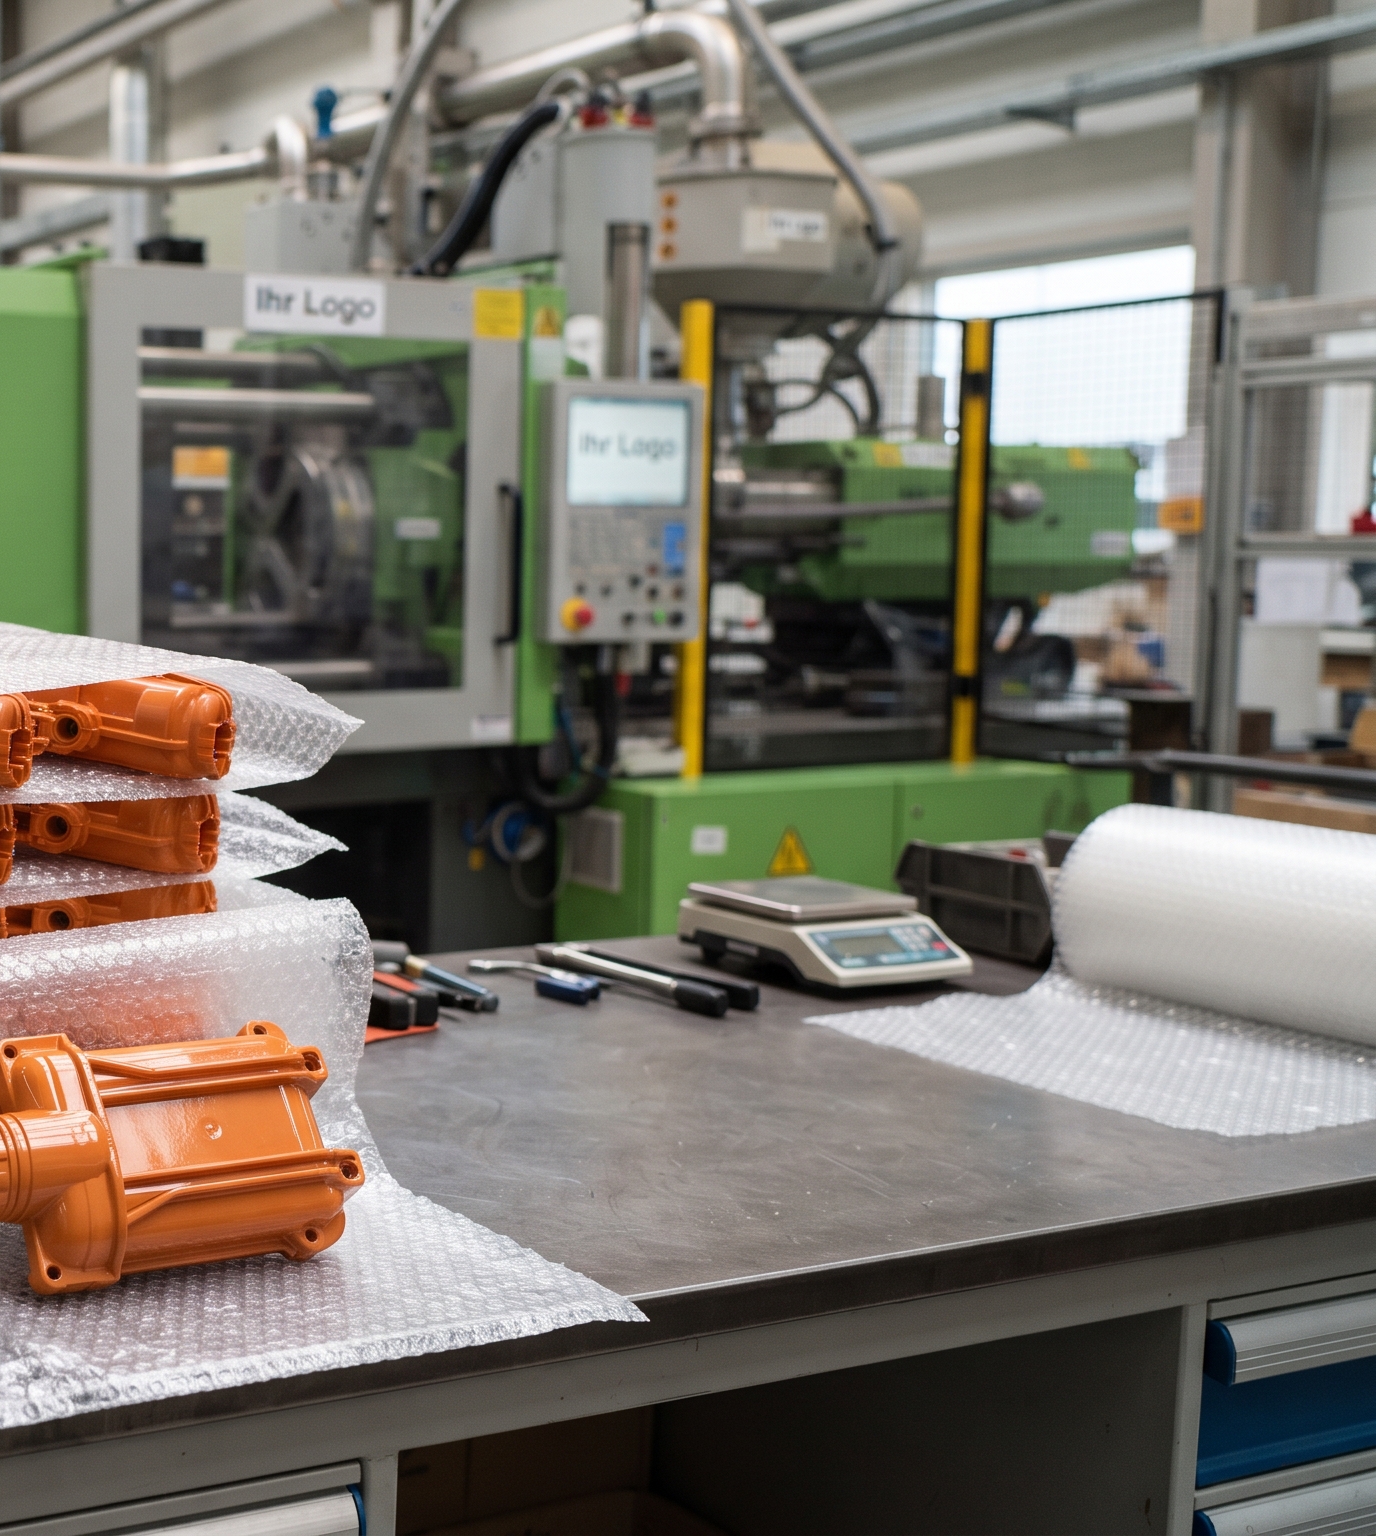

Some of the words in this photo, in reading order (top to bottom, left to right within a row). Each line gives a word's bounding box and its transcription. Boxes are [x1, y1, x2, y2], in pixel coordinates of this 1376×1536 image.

[256, 284, 295, 314] Ihr
[304, 287, 376, 324] Logo
[579, 432, 611, 455] Ihr
[617, 433, 678, 462] Logo
